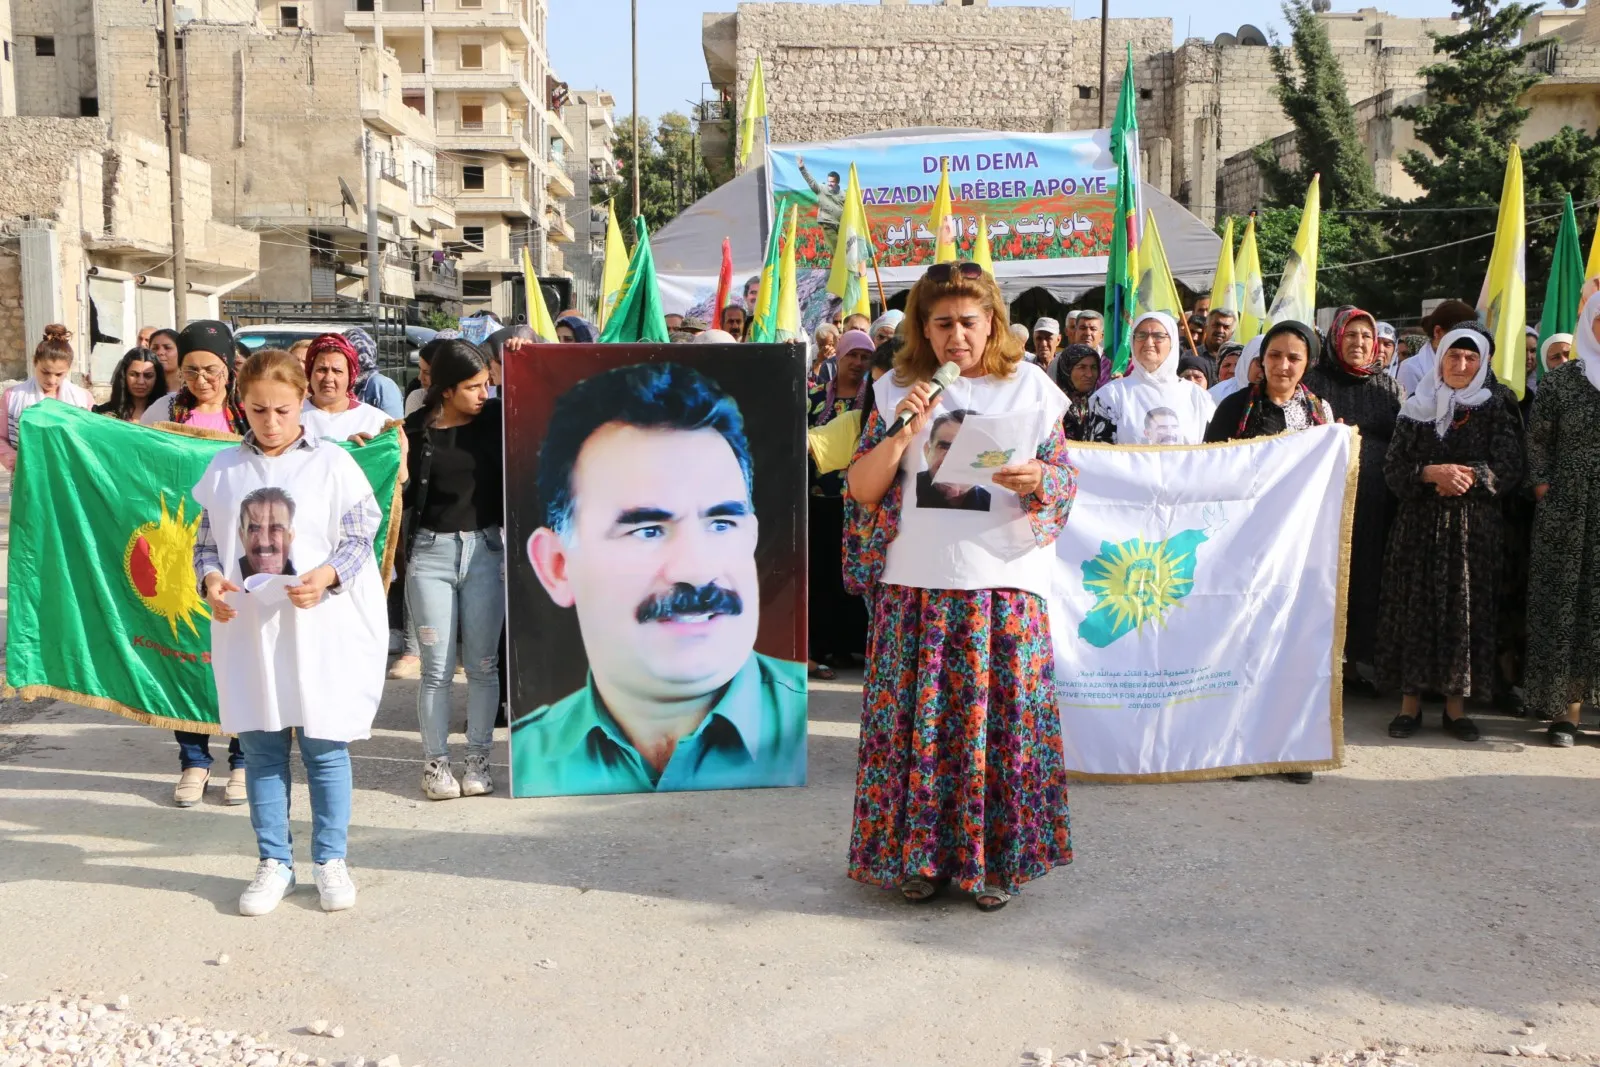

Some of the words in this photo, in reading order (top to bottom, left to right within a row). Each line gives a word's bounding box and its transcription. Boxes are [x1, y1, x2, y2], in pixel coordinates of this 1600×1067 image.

[923, 155, 970, 173] DEM
[976, 152, 1039, 171] DEMA
[961, 179, 1026, 200] RÊBER
[1032, 178, 1077, 196] APO
[1081, 176, 1107, 194] YE
[885, 216, 912, 245] آبو
[968, 216, 1010, 240] حرة
[1015, 213, 1055, 237] وقت
[1059, 212, 1093, 236] حان
[1217, 679, 1239, 689] SYRIA
